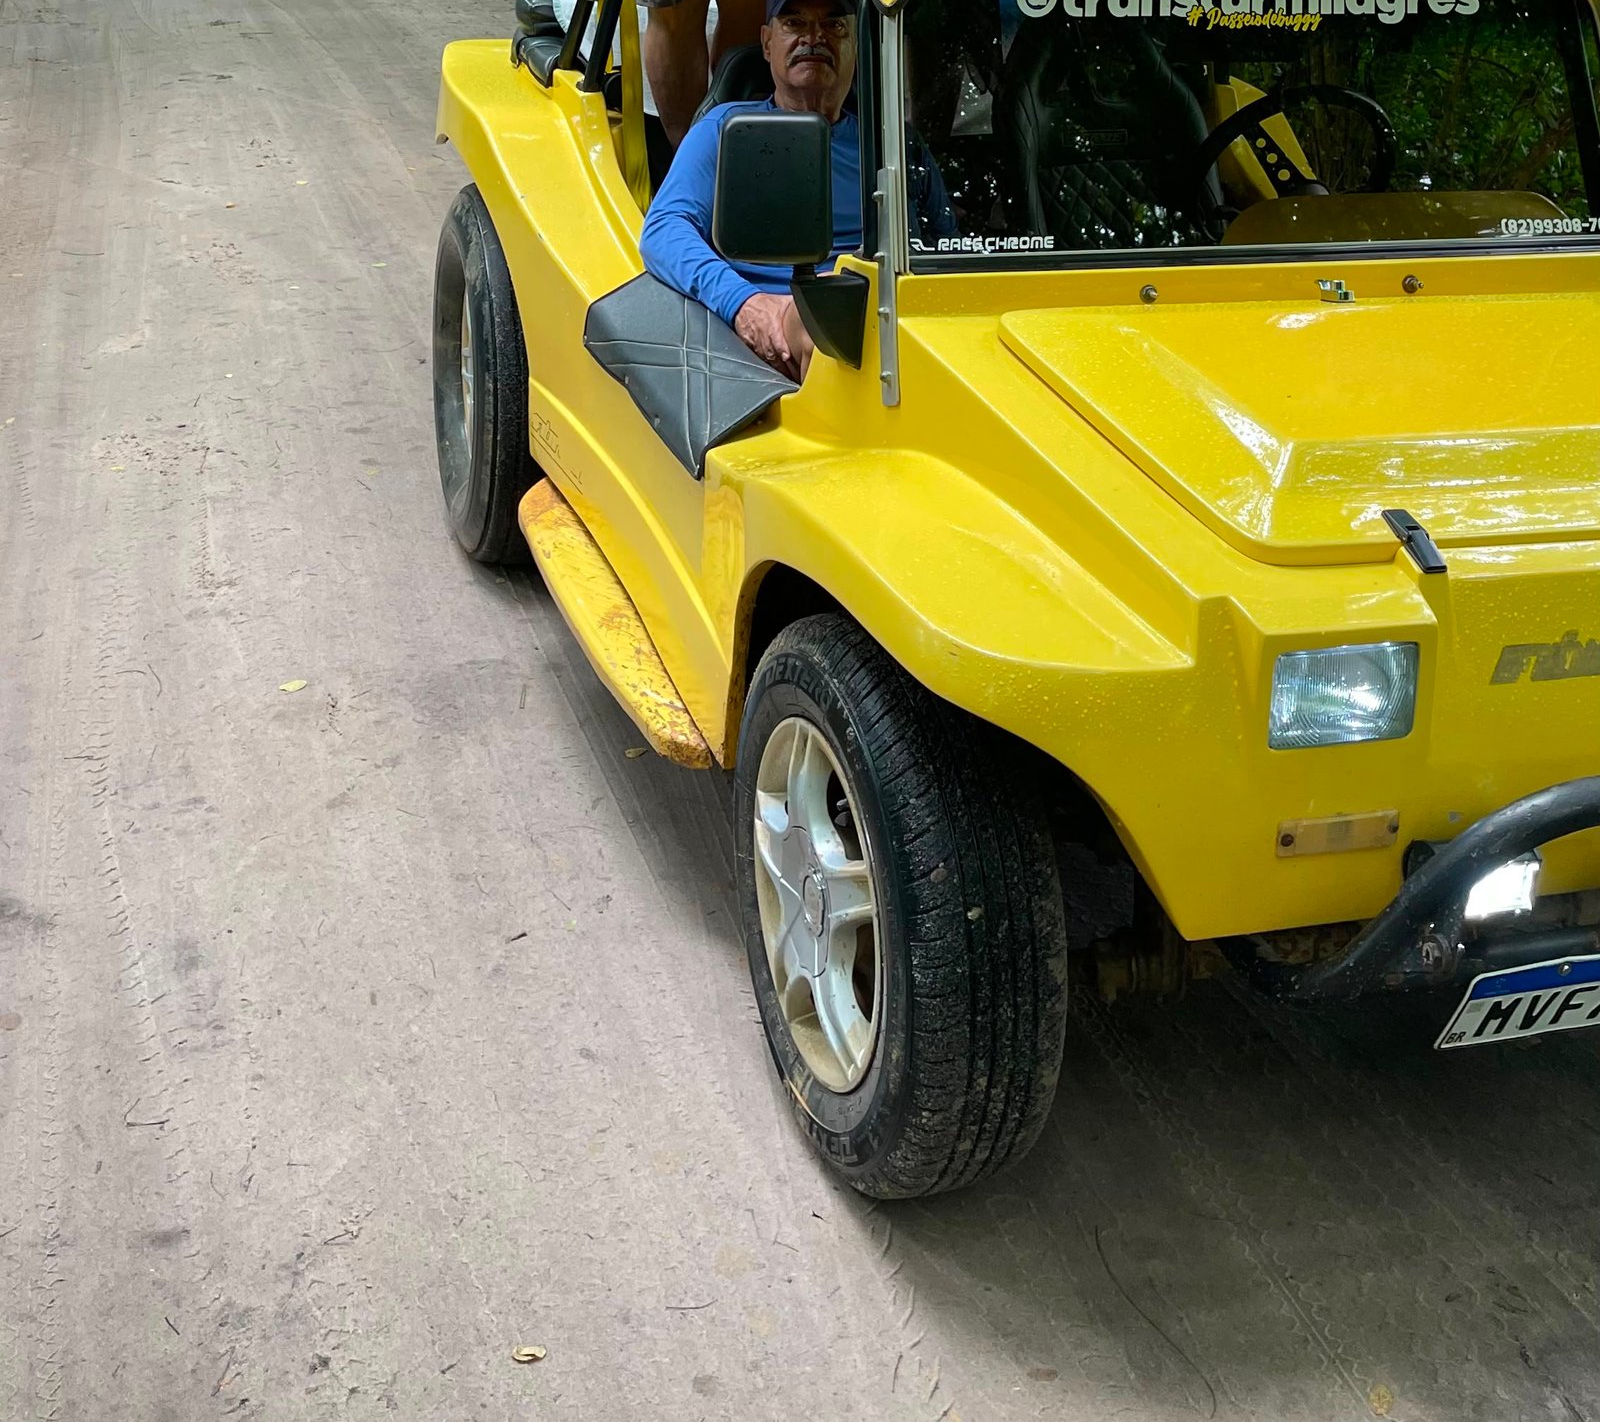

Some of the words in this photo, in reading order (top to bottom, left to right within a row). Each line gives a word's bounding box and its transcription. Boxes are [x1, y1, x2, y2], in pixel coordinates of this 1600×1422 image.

[1500, 218, 1600, 235] (82)99308-7
[1473, 985, 1600, 1038] MVF
[1445, 1031, 1467, 1045] BR
